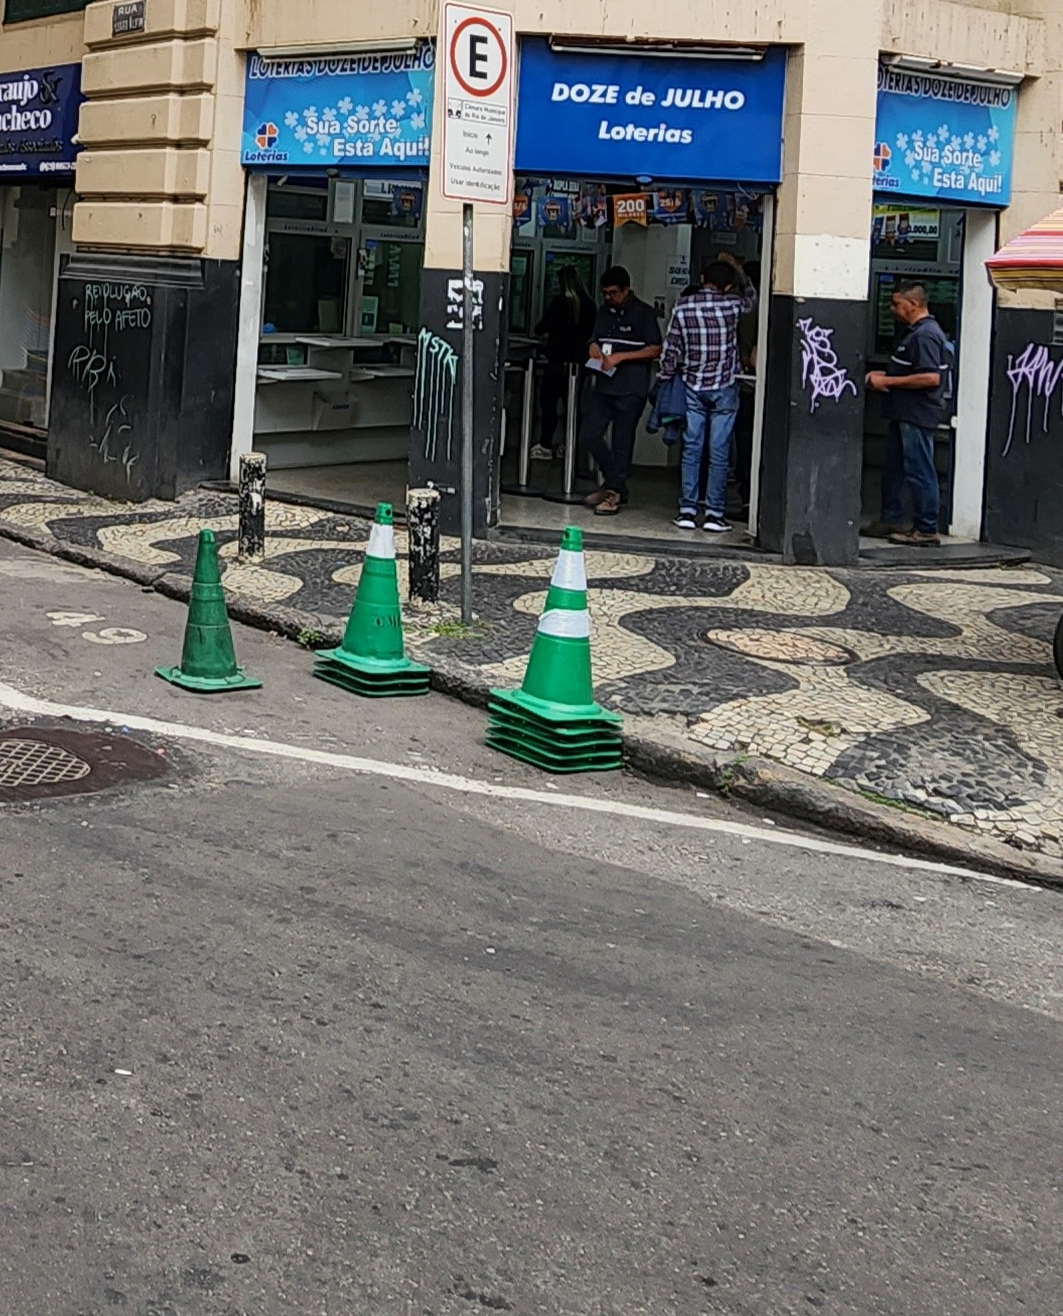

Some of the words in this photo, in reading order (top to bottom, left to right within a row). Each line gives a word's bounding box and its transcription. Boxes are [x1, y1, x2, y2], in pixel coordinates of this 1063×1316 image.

[118, 4, 138, 16] RUA
[469, 34, 488, 80] E
[551, 82, 620, 104] DOZE
[625, 86, 655, 106] de
[660, 88, 746, 110] JULHO
[971, 85, 1012, 109] JULHO
[306, 116, 340, 134] Sua
[346, 116, 398, 134] Sorte
[598, 121, 693, 144] Loterias
[244, 150, 288, 162] Loterias
[914, 141, 939, 163] Sua
[943, 144, 982, 167] Sorte
[873, 174, 899, 187] terias
[968, 172, 1003, 196] Aqui!
[617, 199, 645, 212] 200
[85, 308, 111, 325] PELO
[115, 308, 151, 329] AFETO
